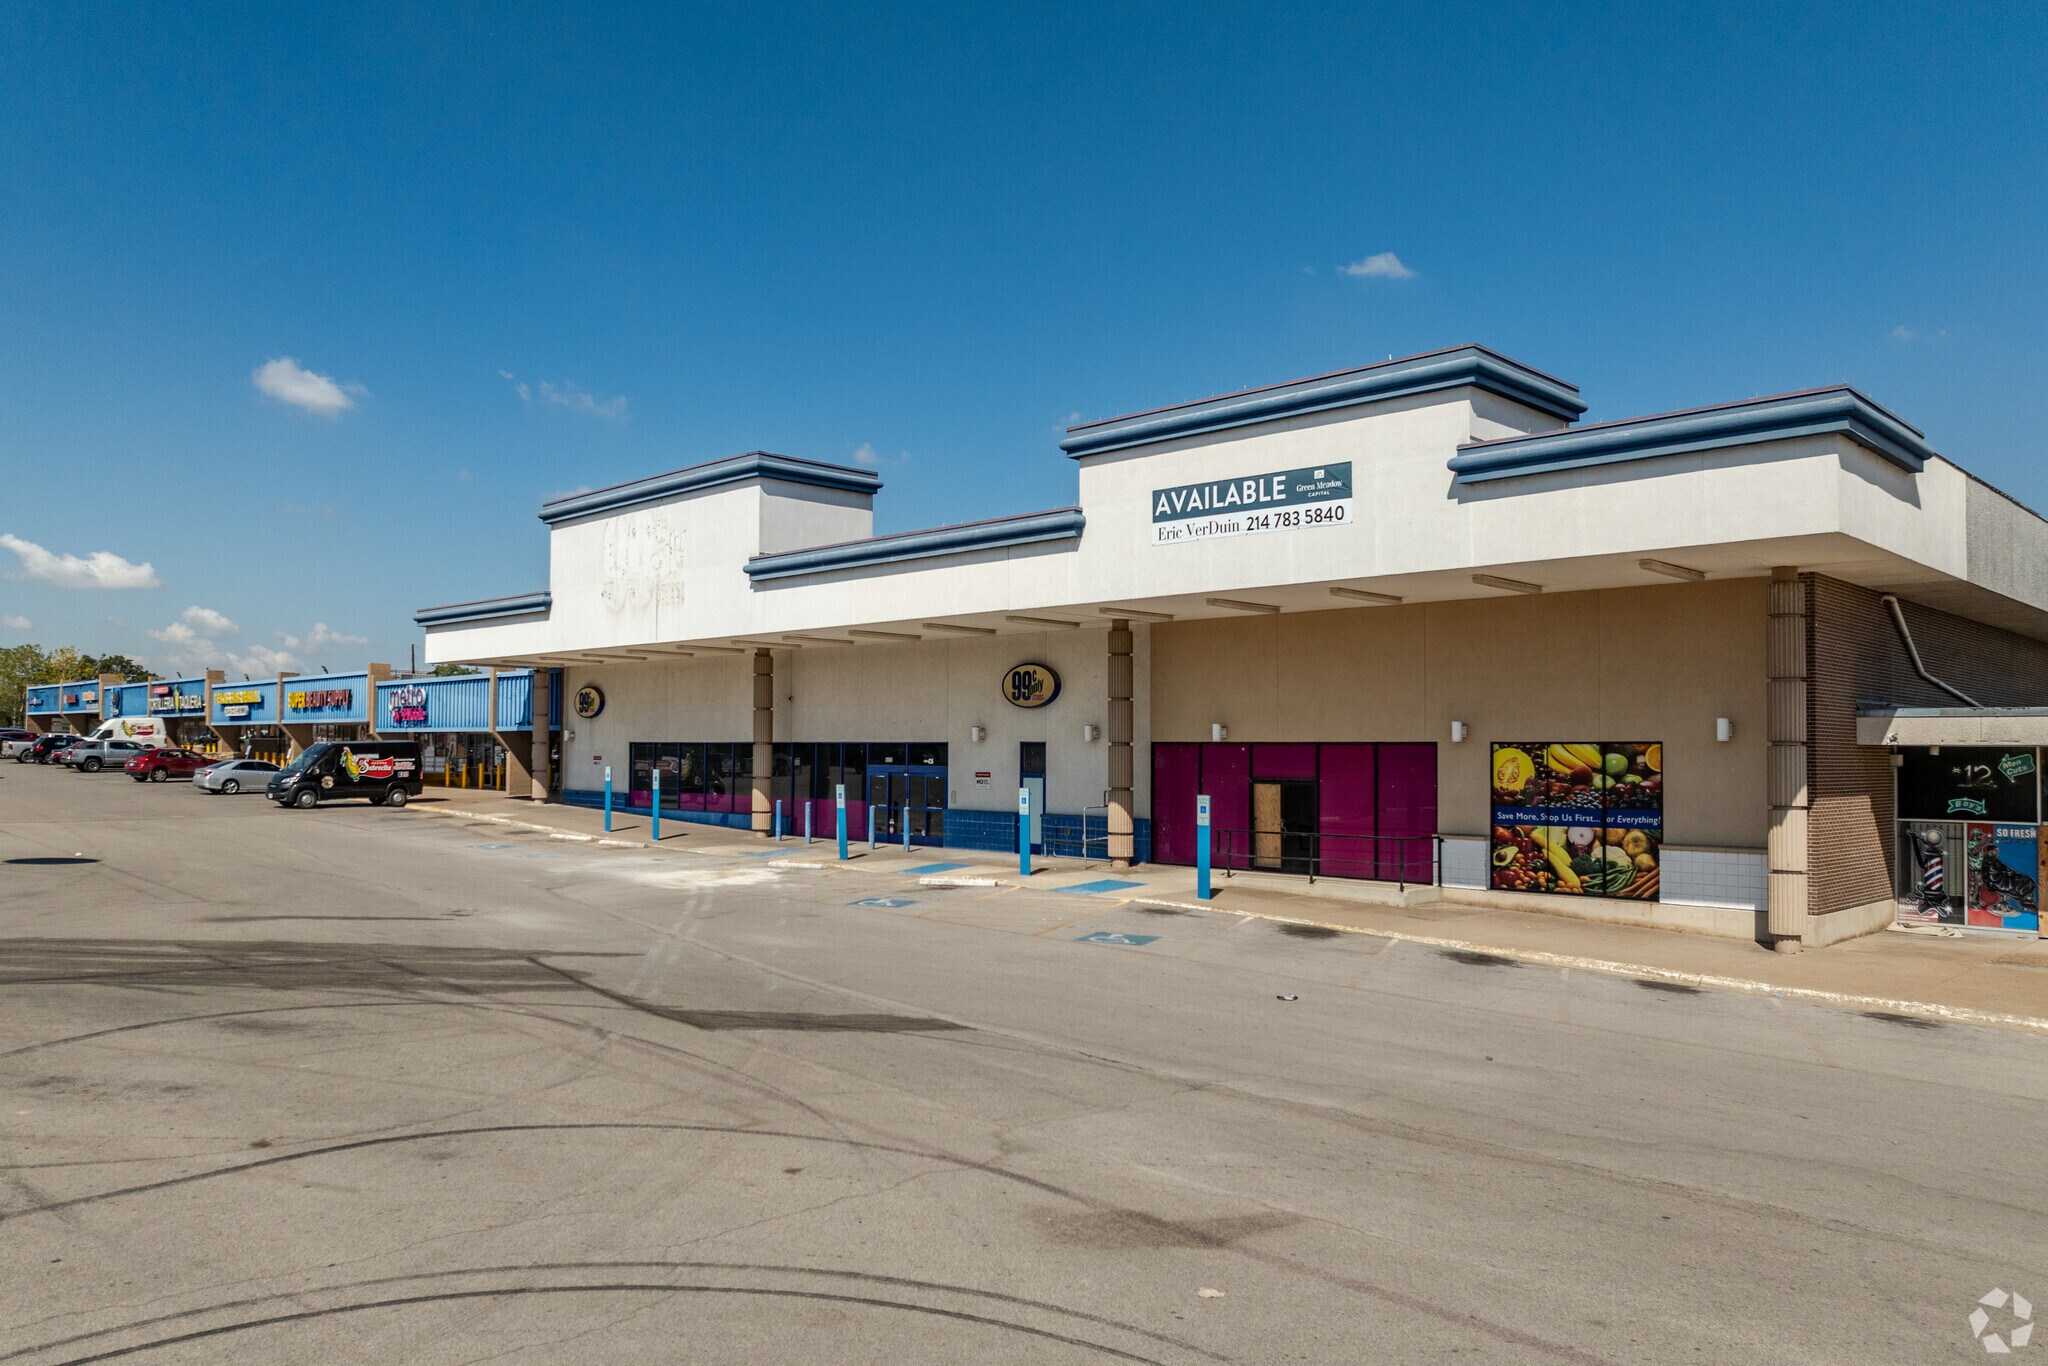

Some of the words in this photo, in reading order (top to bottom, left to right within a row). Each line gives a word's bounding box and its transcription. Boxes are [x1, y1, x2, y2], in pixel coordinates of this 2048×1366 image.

[1296, 483, 1315, 493] Green
[1316, 479, 1343, 490] Meadow
[1155, 475, 1286, 516] AVAILABLE
[1307, 490, 1330, 498] CAPITAL
[1158, 526, 1182, 541] Eric
[1187, 519, 1240, 537] VerDuin
[1246, 514, 1270, 531] 214
[1274, 510, 1300, 528] 783
[1305, 505, 1345, 524] 5840
[1029, 678, 1044, 697] only
[288, 692, 306, 708] SUPER
[306, 690, 327, 707] BEAUTY
[327, 689, 350, 706] SUPPLY
[390, 684, 426, 707] metro
[2002, 759, 2022, 769] Men
[2006, 765, 2028, 775] Cuts
[1955, 801, 1982, 811] Boy's
[1497, 811, 1514, 820] Save
[1617, 814, 1661, 826] Everything!
[1996, 828, 2008, 837] SO
[2010, 828, 2037, 838] FRESH
